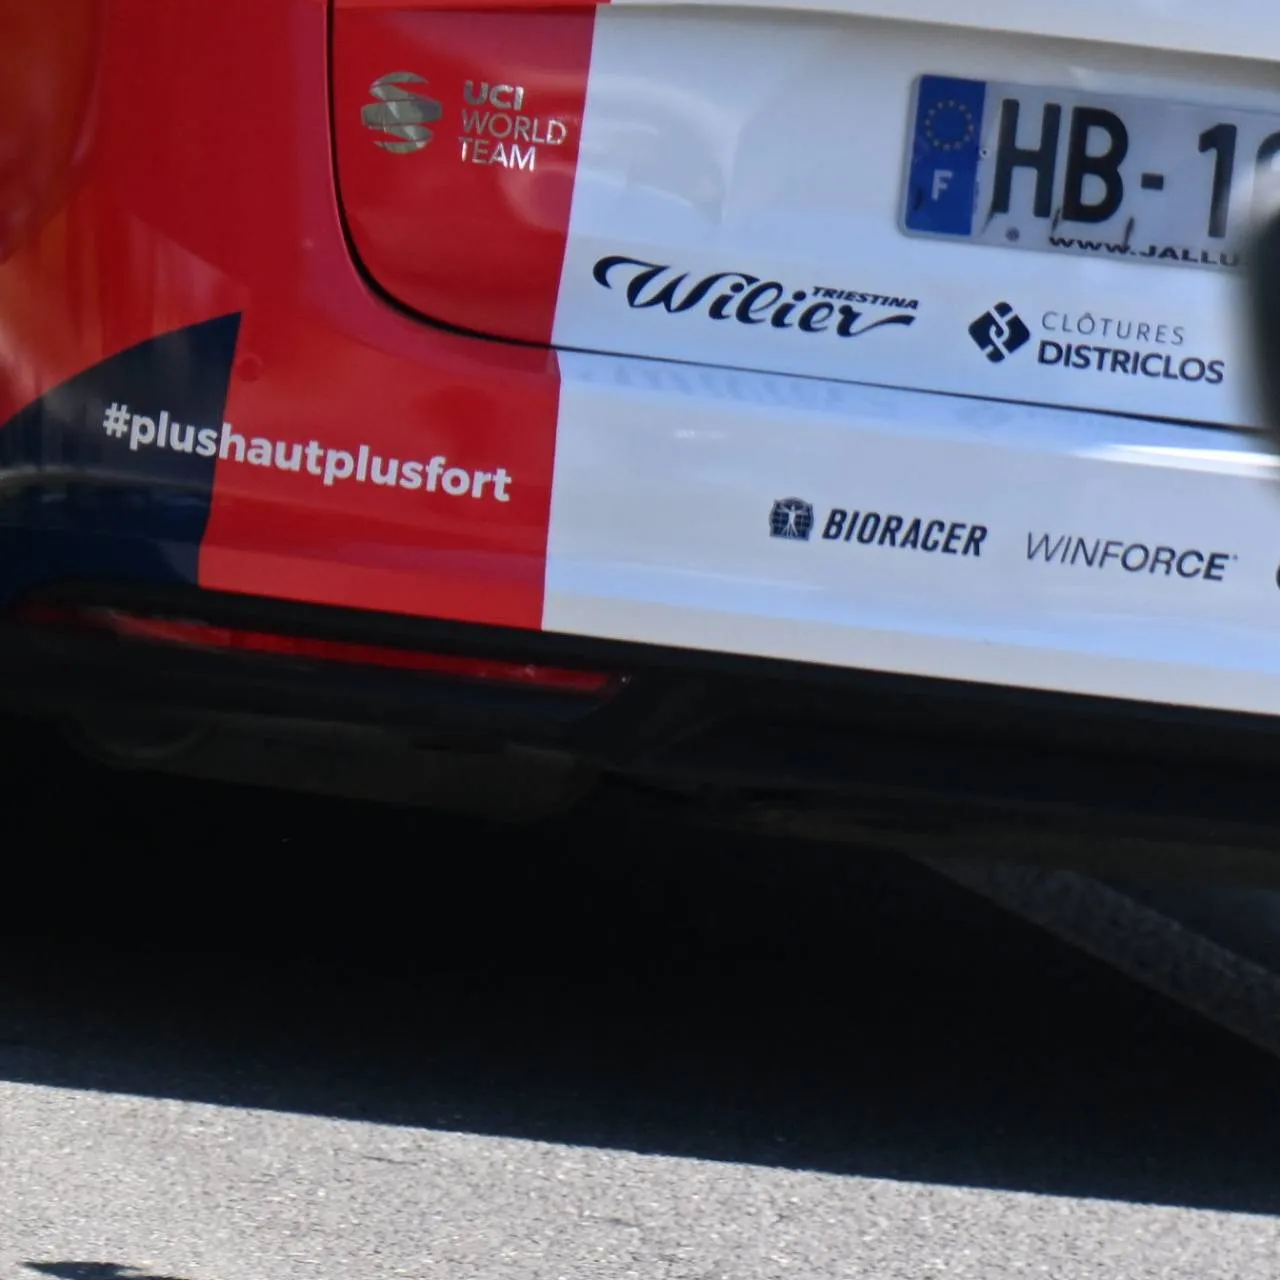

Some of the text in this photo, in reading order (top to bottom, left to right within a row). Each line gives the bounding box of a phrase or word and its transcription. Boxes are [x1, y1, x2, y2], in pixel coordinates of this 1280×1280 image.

[463, 79, 525, 112] UCI
[461, 108, 568, 145] WORLD
[458, 136, 537, 173] TEAM
[931, 169, 954, 202] F
[1048, 236, 1242, 269] www.JALLU
[592, 254, 916, 338] Wilier
[811, 286, 919, 310] TRIESTINA
[1041, 311, 1185, 347] CLÔTURES
[1037, 340, 1225, 385] DISTRICLOS
[102, 402, 513, 502] #plushautplusfort
[822, 508, 987, 558] BIORACER
[1025, 531, 1229, 582] WINFORCE
